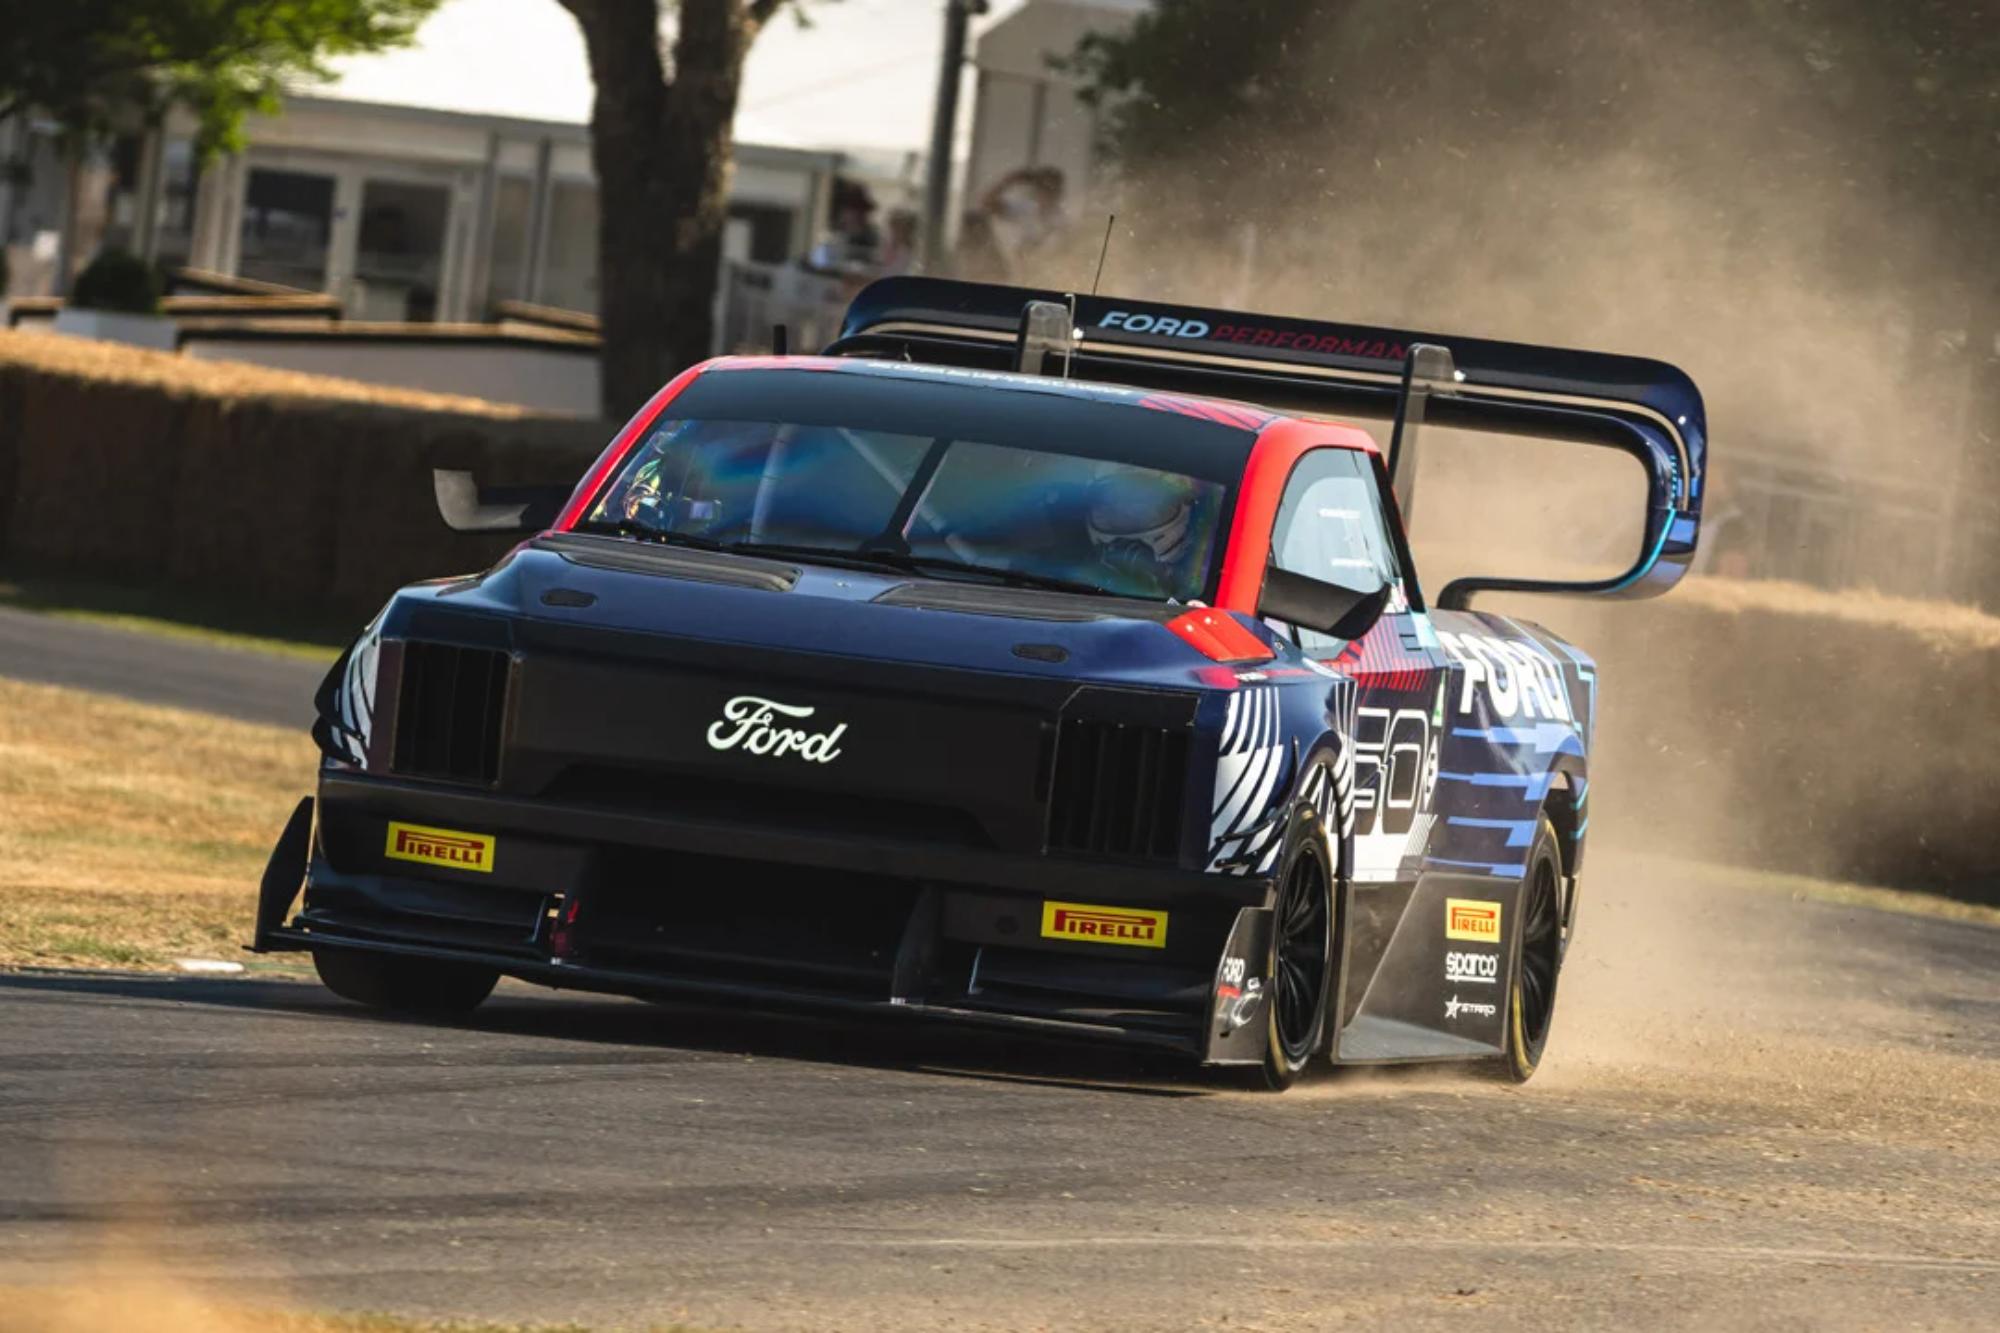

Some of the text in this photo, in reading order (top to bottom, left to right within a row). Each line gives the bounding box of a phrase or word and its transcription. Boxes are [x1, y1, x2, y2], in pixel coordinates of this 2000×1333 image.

[1097, 310, 1409, 359] FORD PERFORMAN
[1437, 631, 1570, 721] FORD
[706, 696, 848, 763] Ford
[396, 830, 485, 864] PIRELLI
[1053, 909, 1157, 940] PIRELLI
[1452, 907, 1496, 933] PIRELLI
[1445, 951, 1498, 983] sparco
